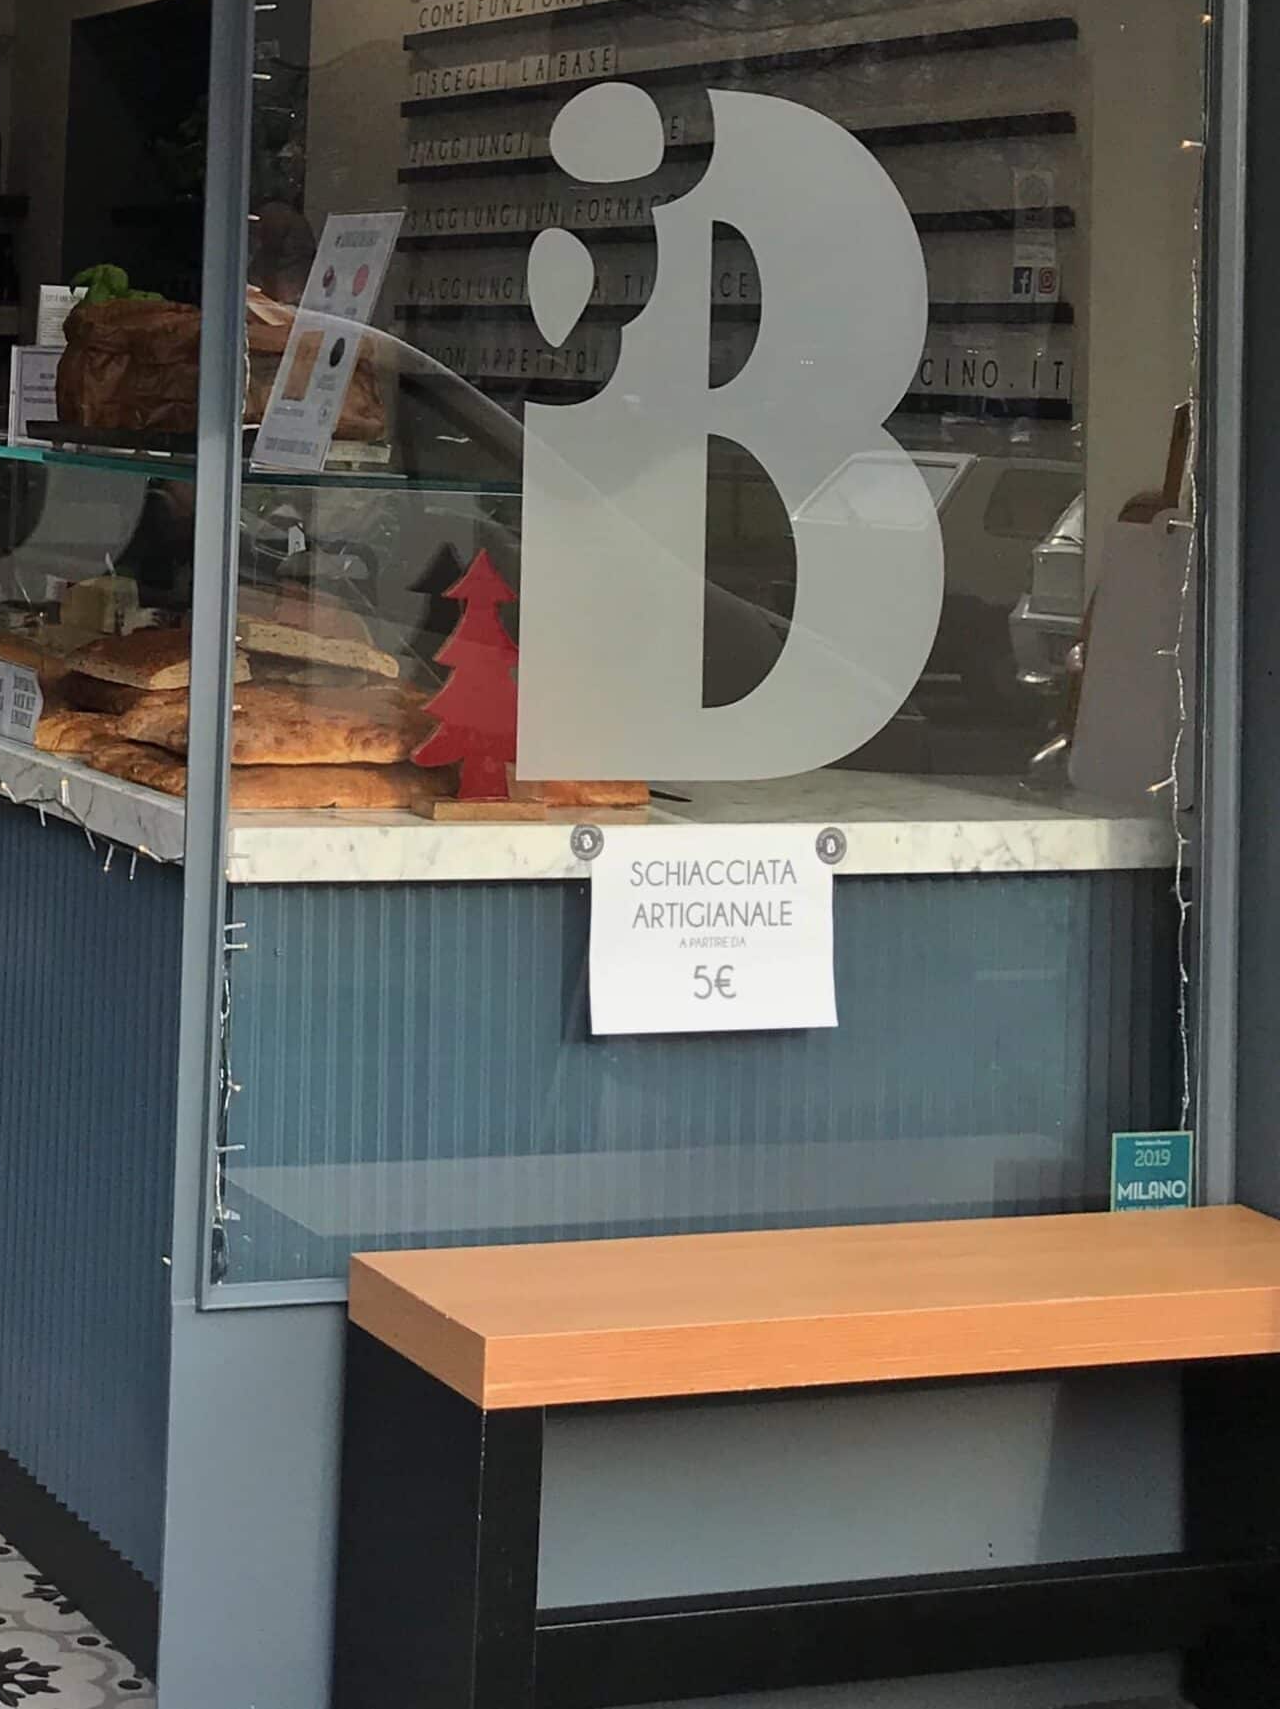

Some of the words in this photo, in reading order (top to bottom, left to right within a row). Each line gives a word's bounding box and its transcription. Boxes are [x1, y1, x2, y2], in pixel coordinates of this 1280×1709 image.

[418, 1, 466, 29] COME
[430, 64, 501, 95] SCEGLI
[522, 57, 545, 82] LA
[558, 47, 611, 78] BASE
[535, 200, 558, 225] UN
[919, 358, 1063, 390] CINO.IT
[629, 859, 798, 887] SCHIACCIATA
[631, 900, 793, 929] ARTIGIANALE
[692, 964, 738, 1000] 5€
[1134, 1148, 1172, 1167] 2019
[1117, 1179, 1187, 1201] MILANO
